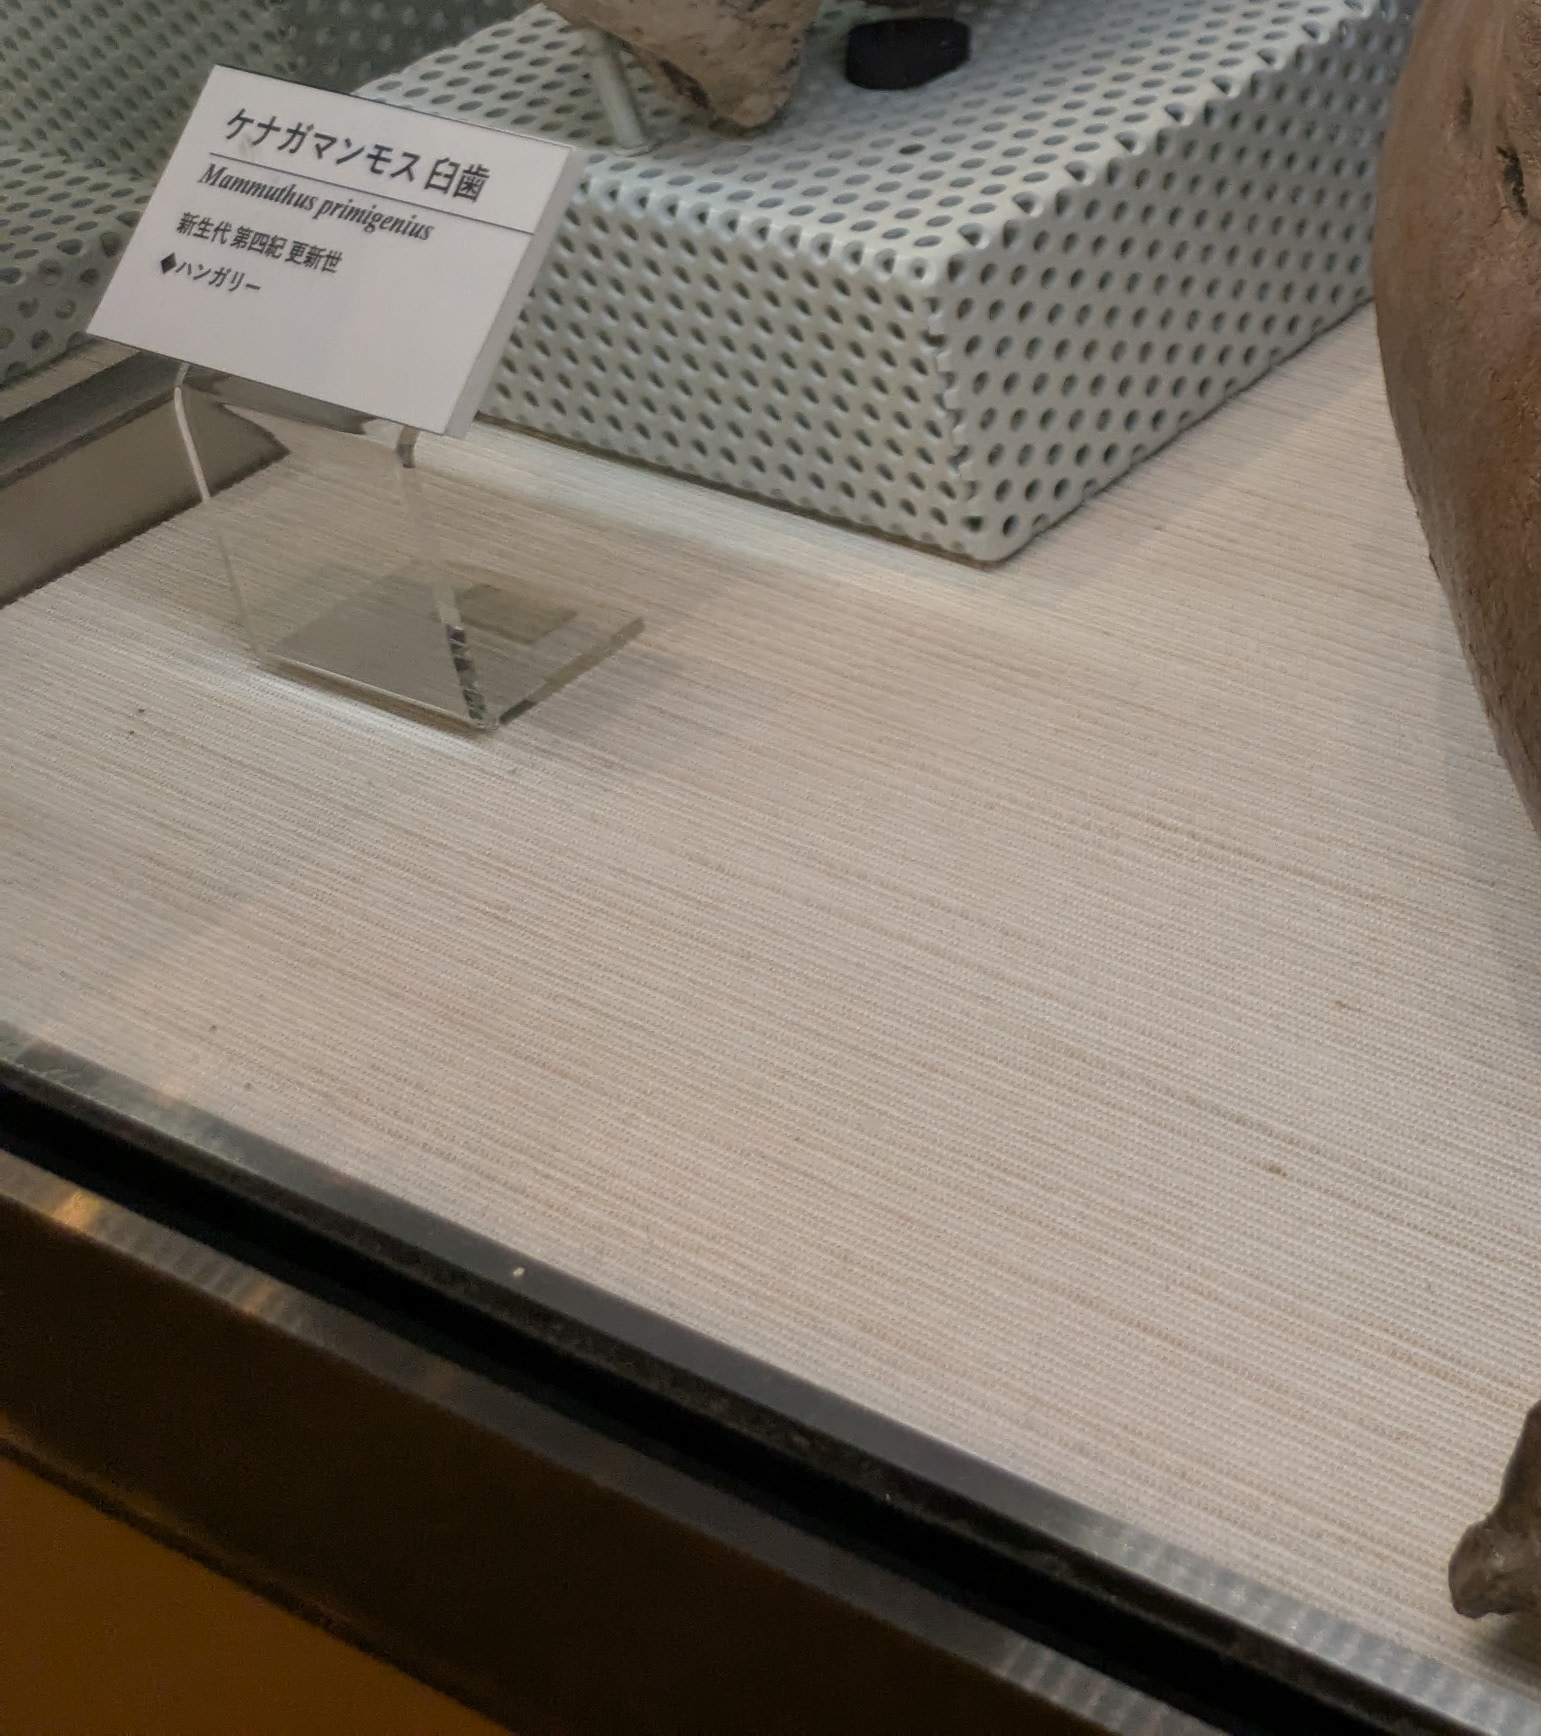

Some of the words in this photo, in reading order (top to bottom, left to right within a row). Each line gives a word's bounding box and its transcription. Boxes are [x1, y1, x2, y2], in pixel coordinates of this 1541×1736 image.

[226, 107, 421, 183] ケナガマンモス
[424, 157, 490, 203] 臼歯
[198, 163, 318, 211] Mammuthus
[312, 198, 435, 242] primigenius
[175, 261, 261, 292] ハンガリー
[176, 212, 232, 244] 新生代
[230, 225, 288, 259] 第四紀
[285, 240, 343, 273] 更新世
